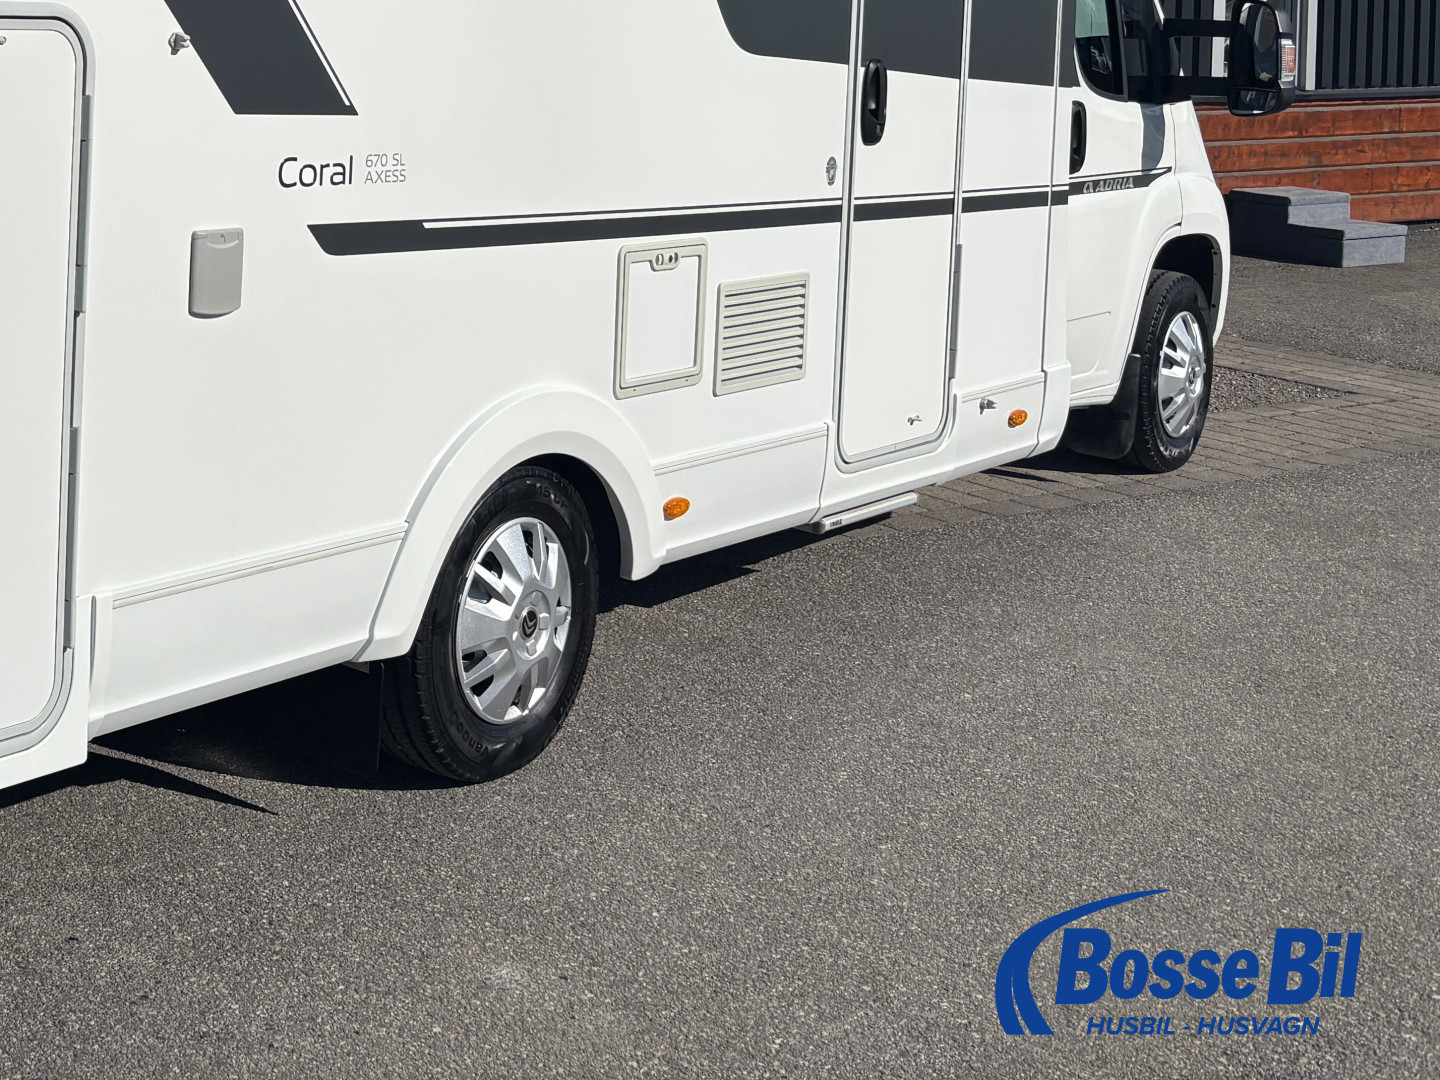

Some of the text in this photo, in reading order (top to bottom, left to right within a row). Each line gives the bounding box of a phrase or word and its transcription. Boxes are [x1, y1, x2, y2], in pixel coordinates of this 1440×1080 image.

[365, 152, 406, 168] 670 SL
[277, 155, 354, 188] Coral
[364, 169, 407, 184] AXESS
[1095, 176, 1134, 193] ADRIA
